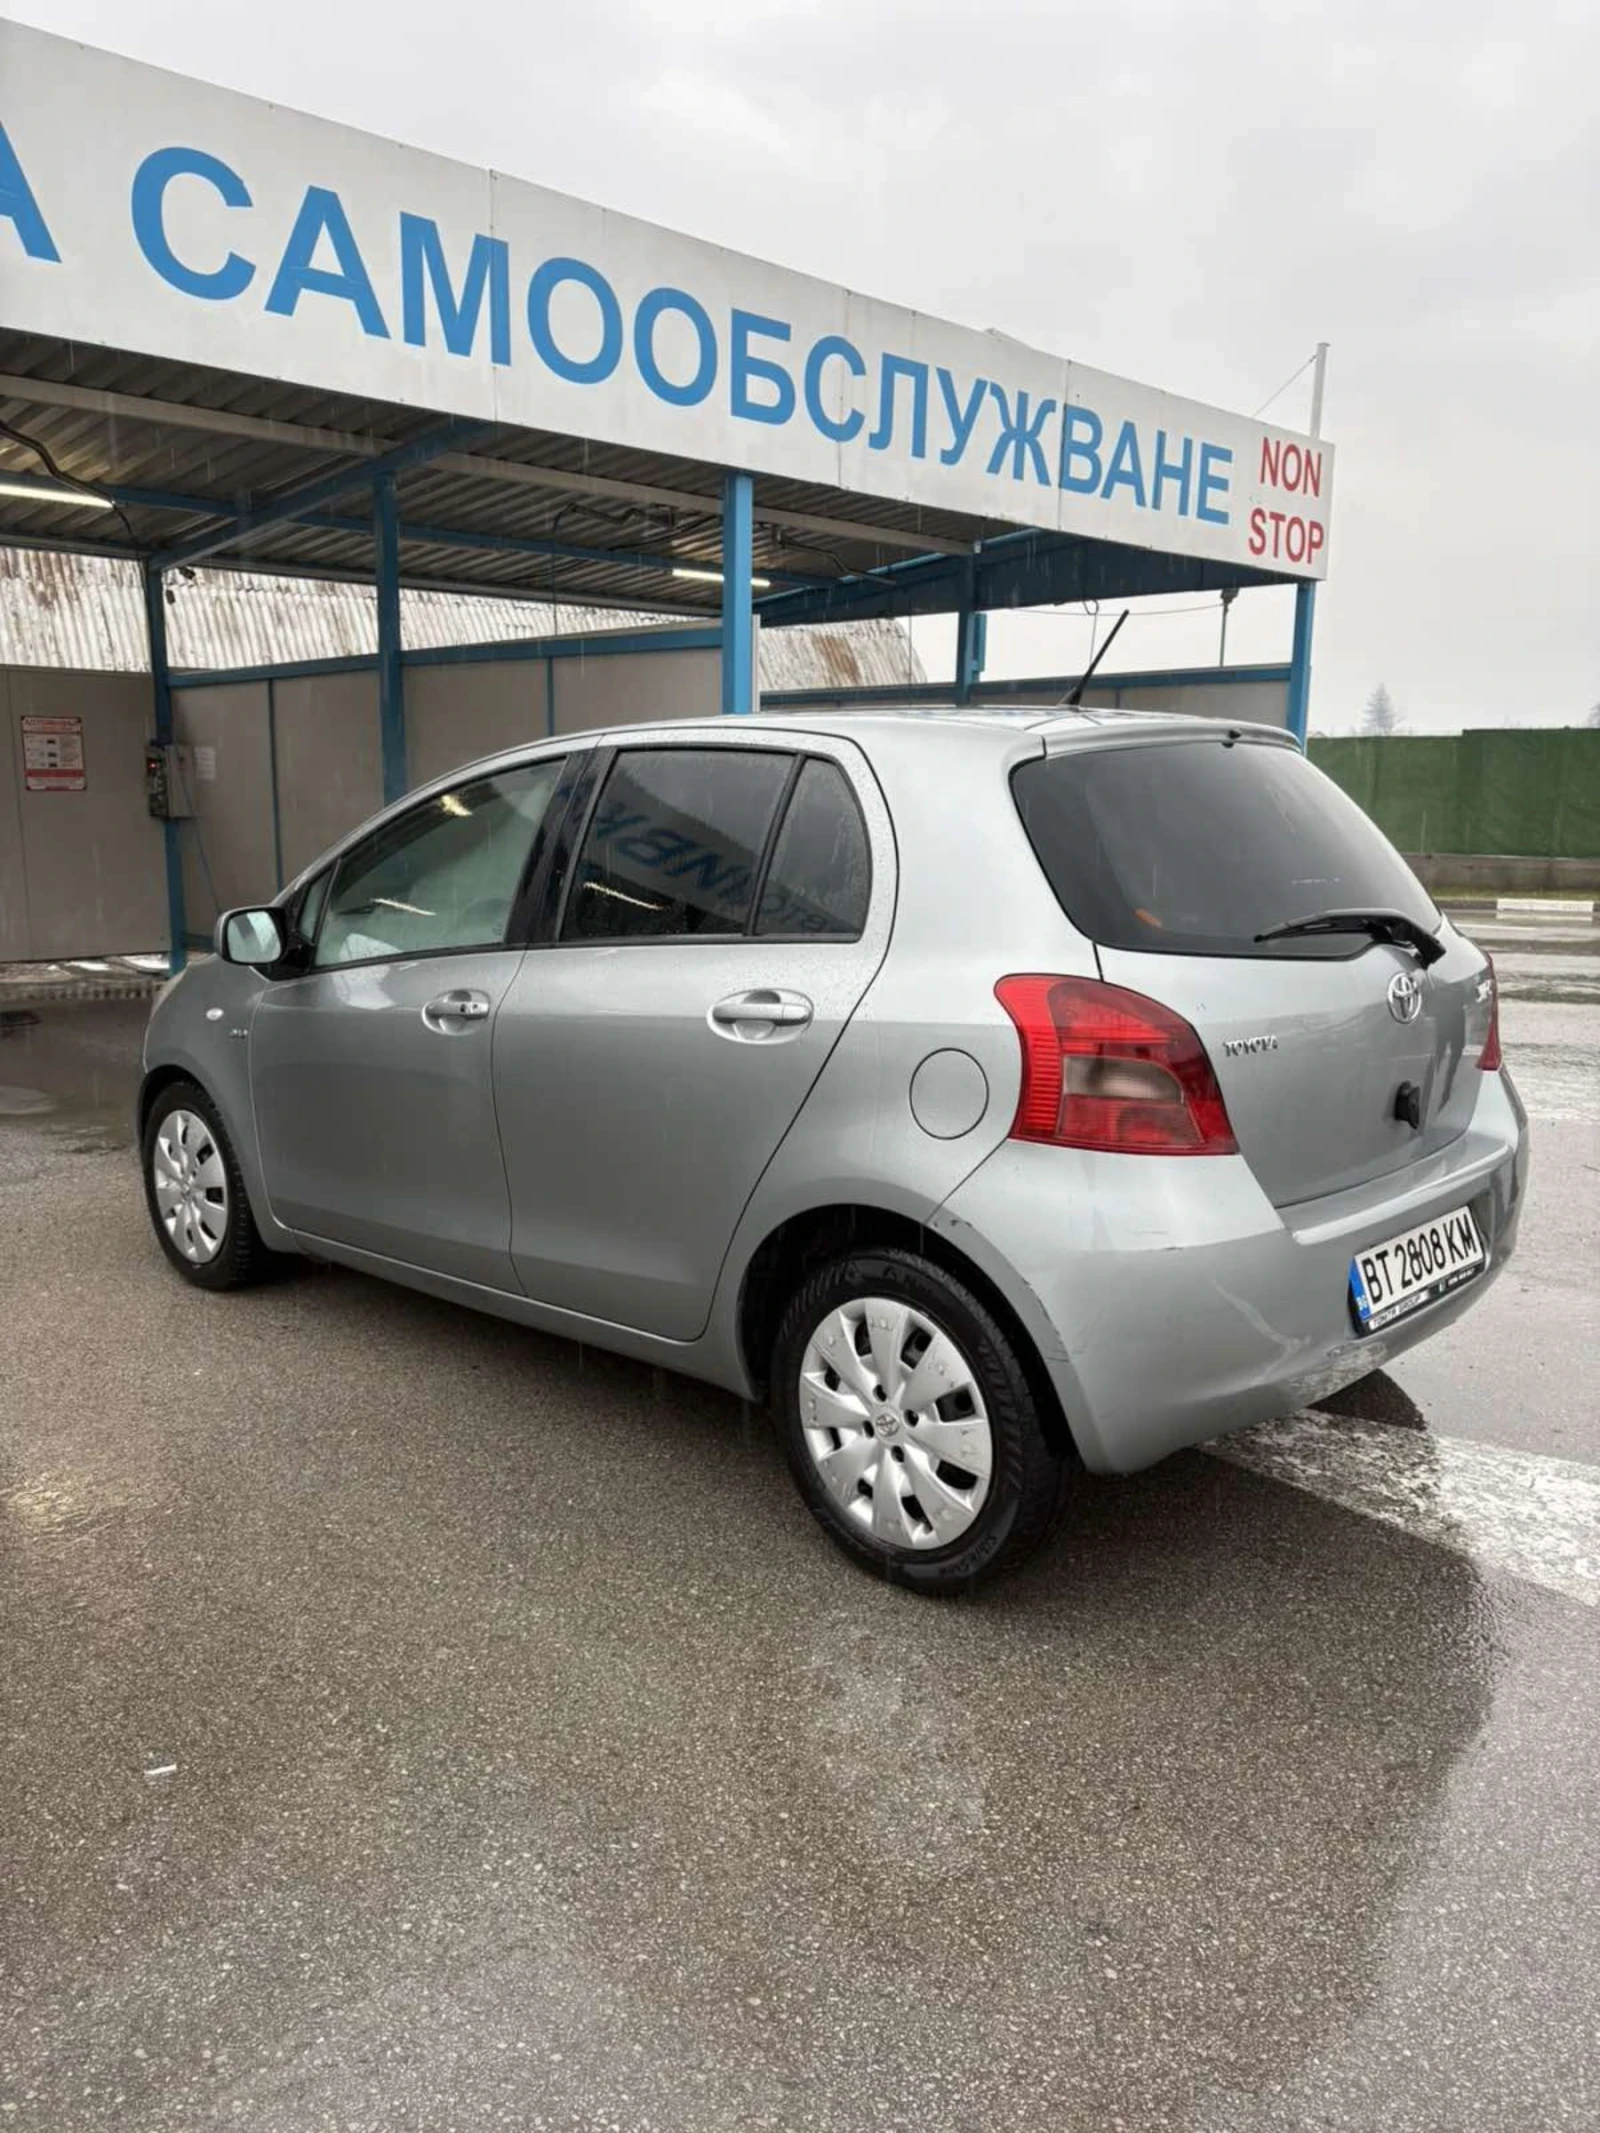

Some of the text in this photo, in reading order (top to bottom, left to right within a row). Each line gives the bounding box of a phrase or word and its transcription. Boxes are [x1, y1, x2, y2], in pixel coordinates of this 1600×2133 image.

[131, 147, 1233, 525] САМООБСЛУЖВАНЕ
[1259, 438, 1322, 497] NON
[1248, 507, 1324, 565] STOP
[1362, 1213, 1478, 1304] BT 2808 KM
